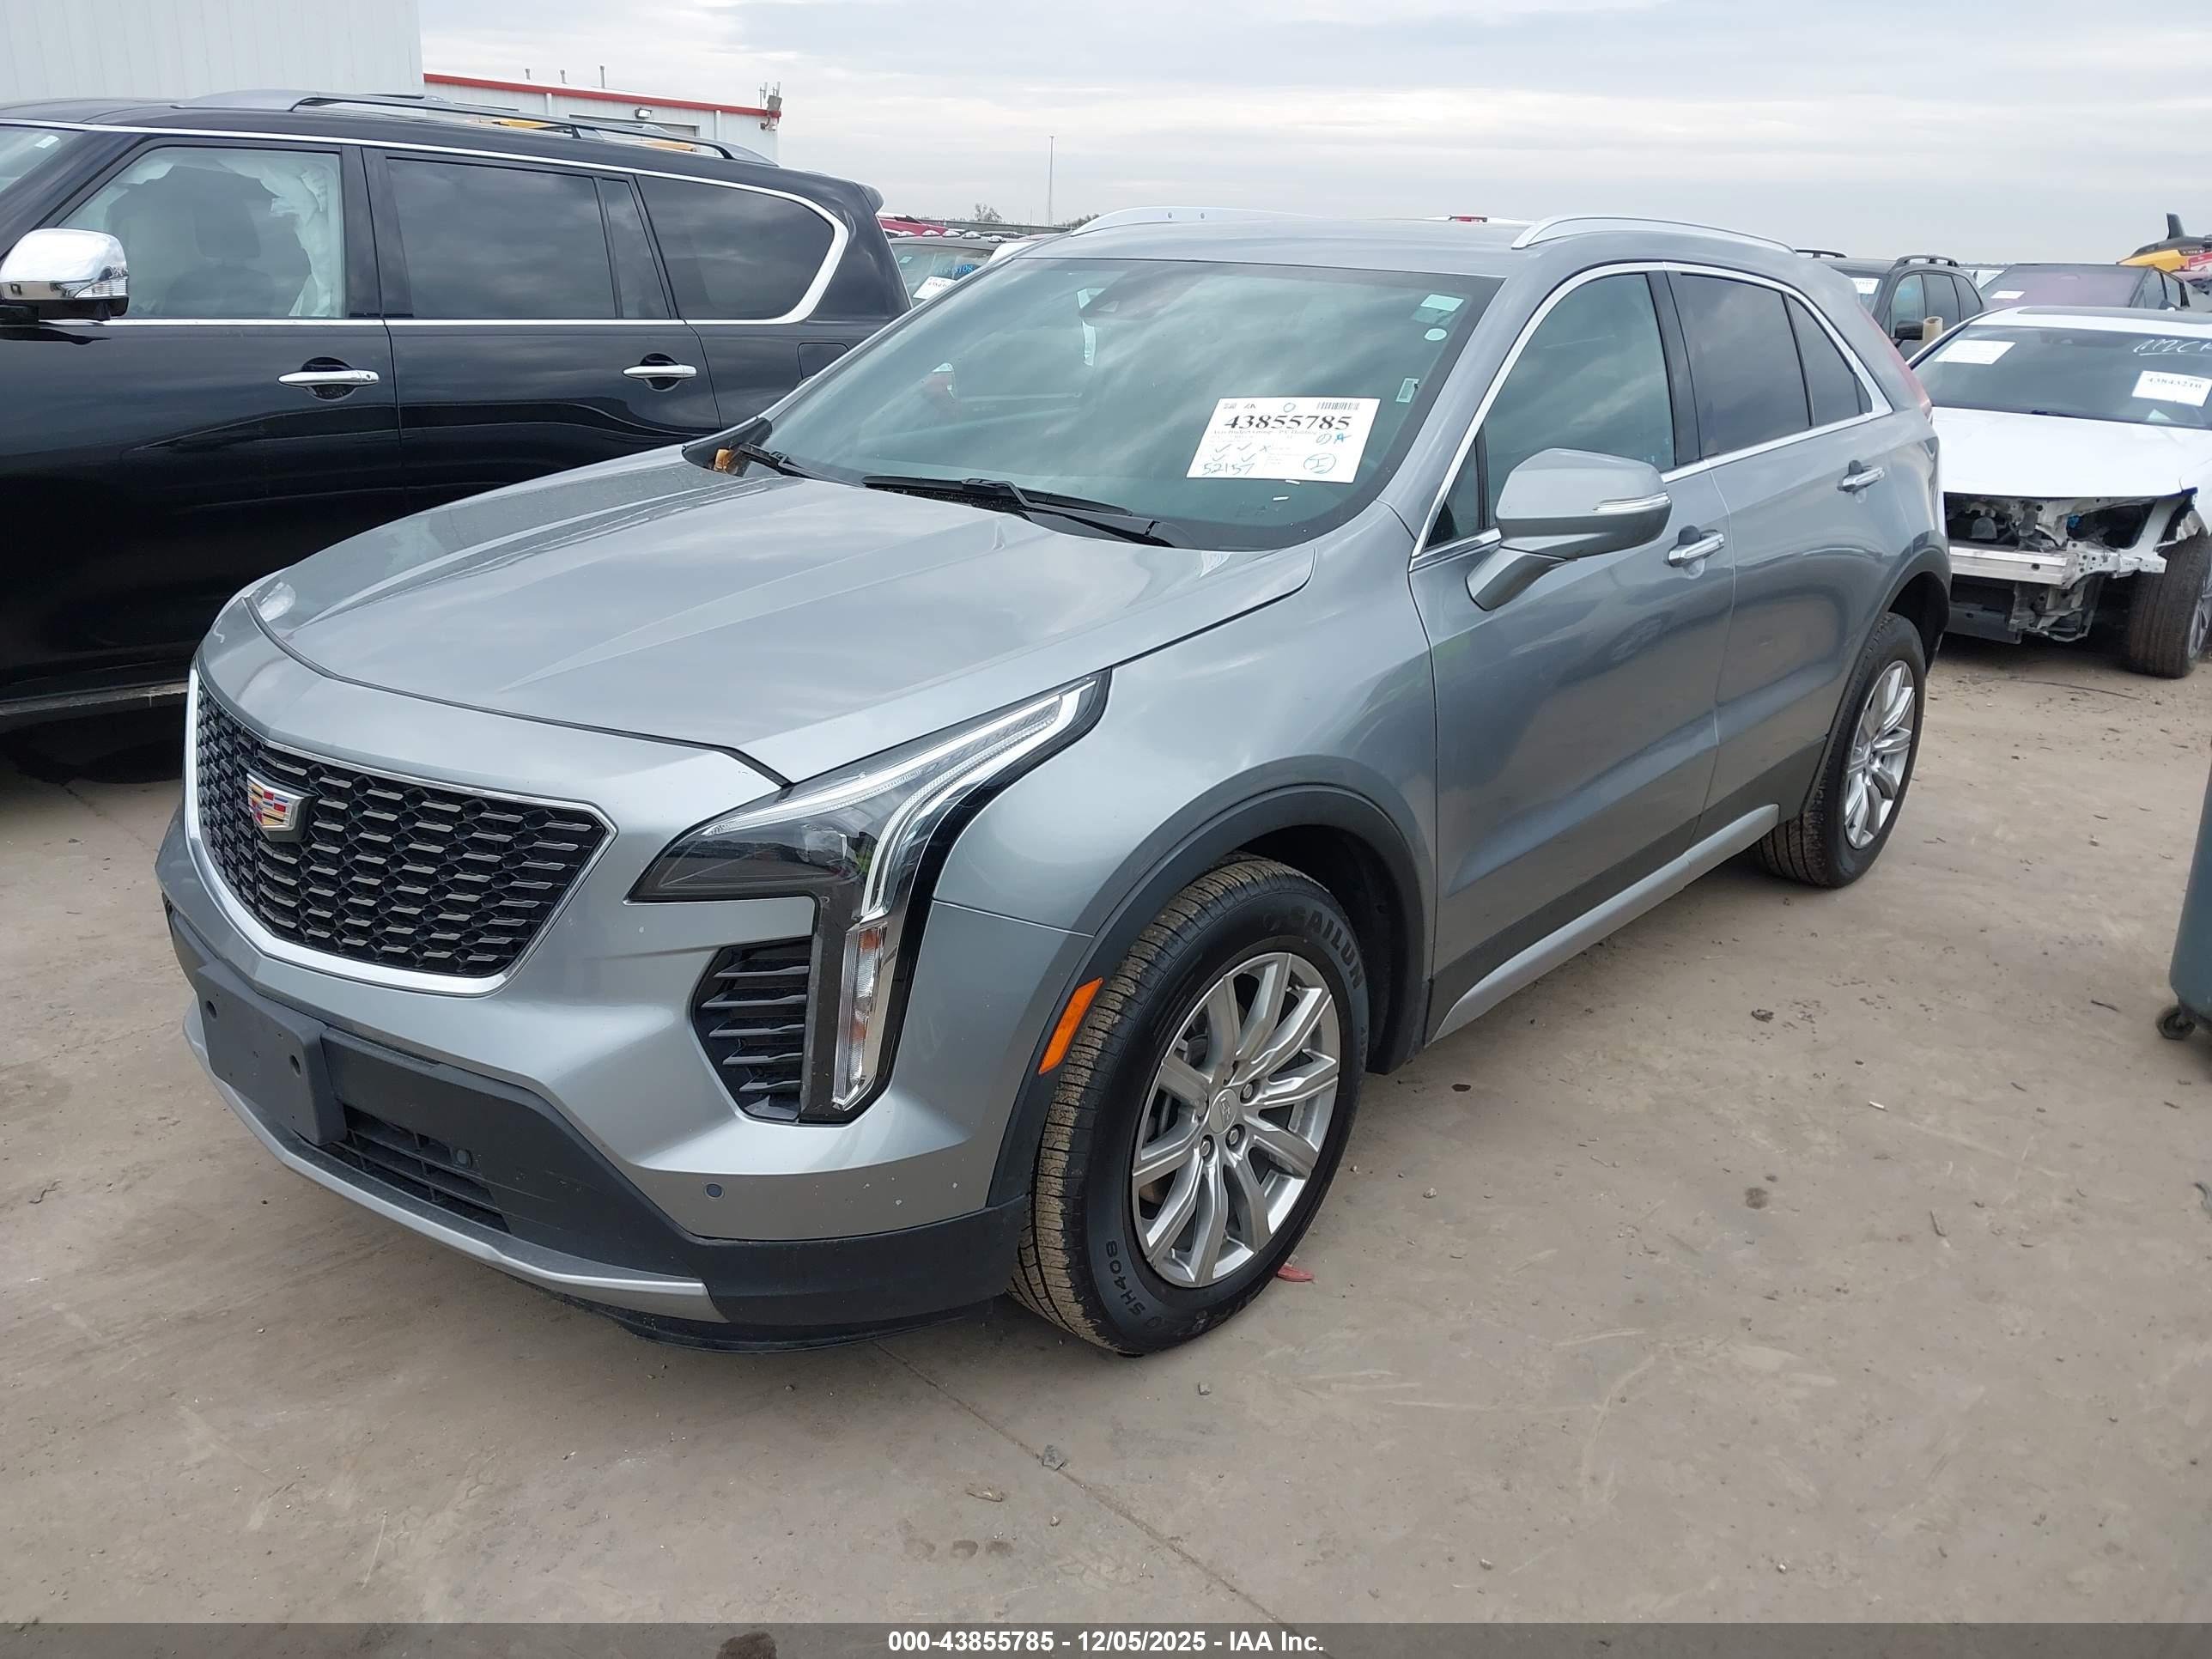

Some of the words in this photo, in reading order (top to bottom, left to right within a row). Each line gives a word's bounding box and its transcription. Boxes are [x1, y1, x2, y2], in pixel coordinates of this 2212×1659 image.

[1224, 415, 1352, 430] 43855785
[1201, 462, 1255, 475] 52157
[1290, 906, 1364, 990] SAILUN
[1105, 1239, 1146, 1317] SH408
